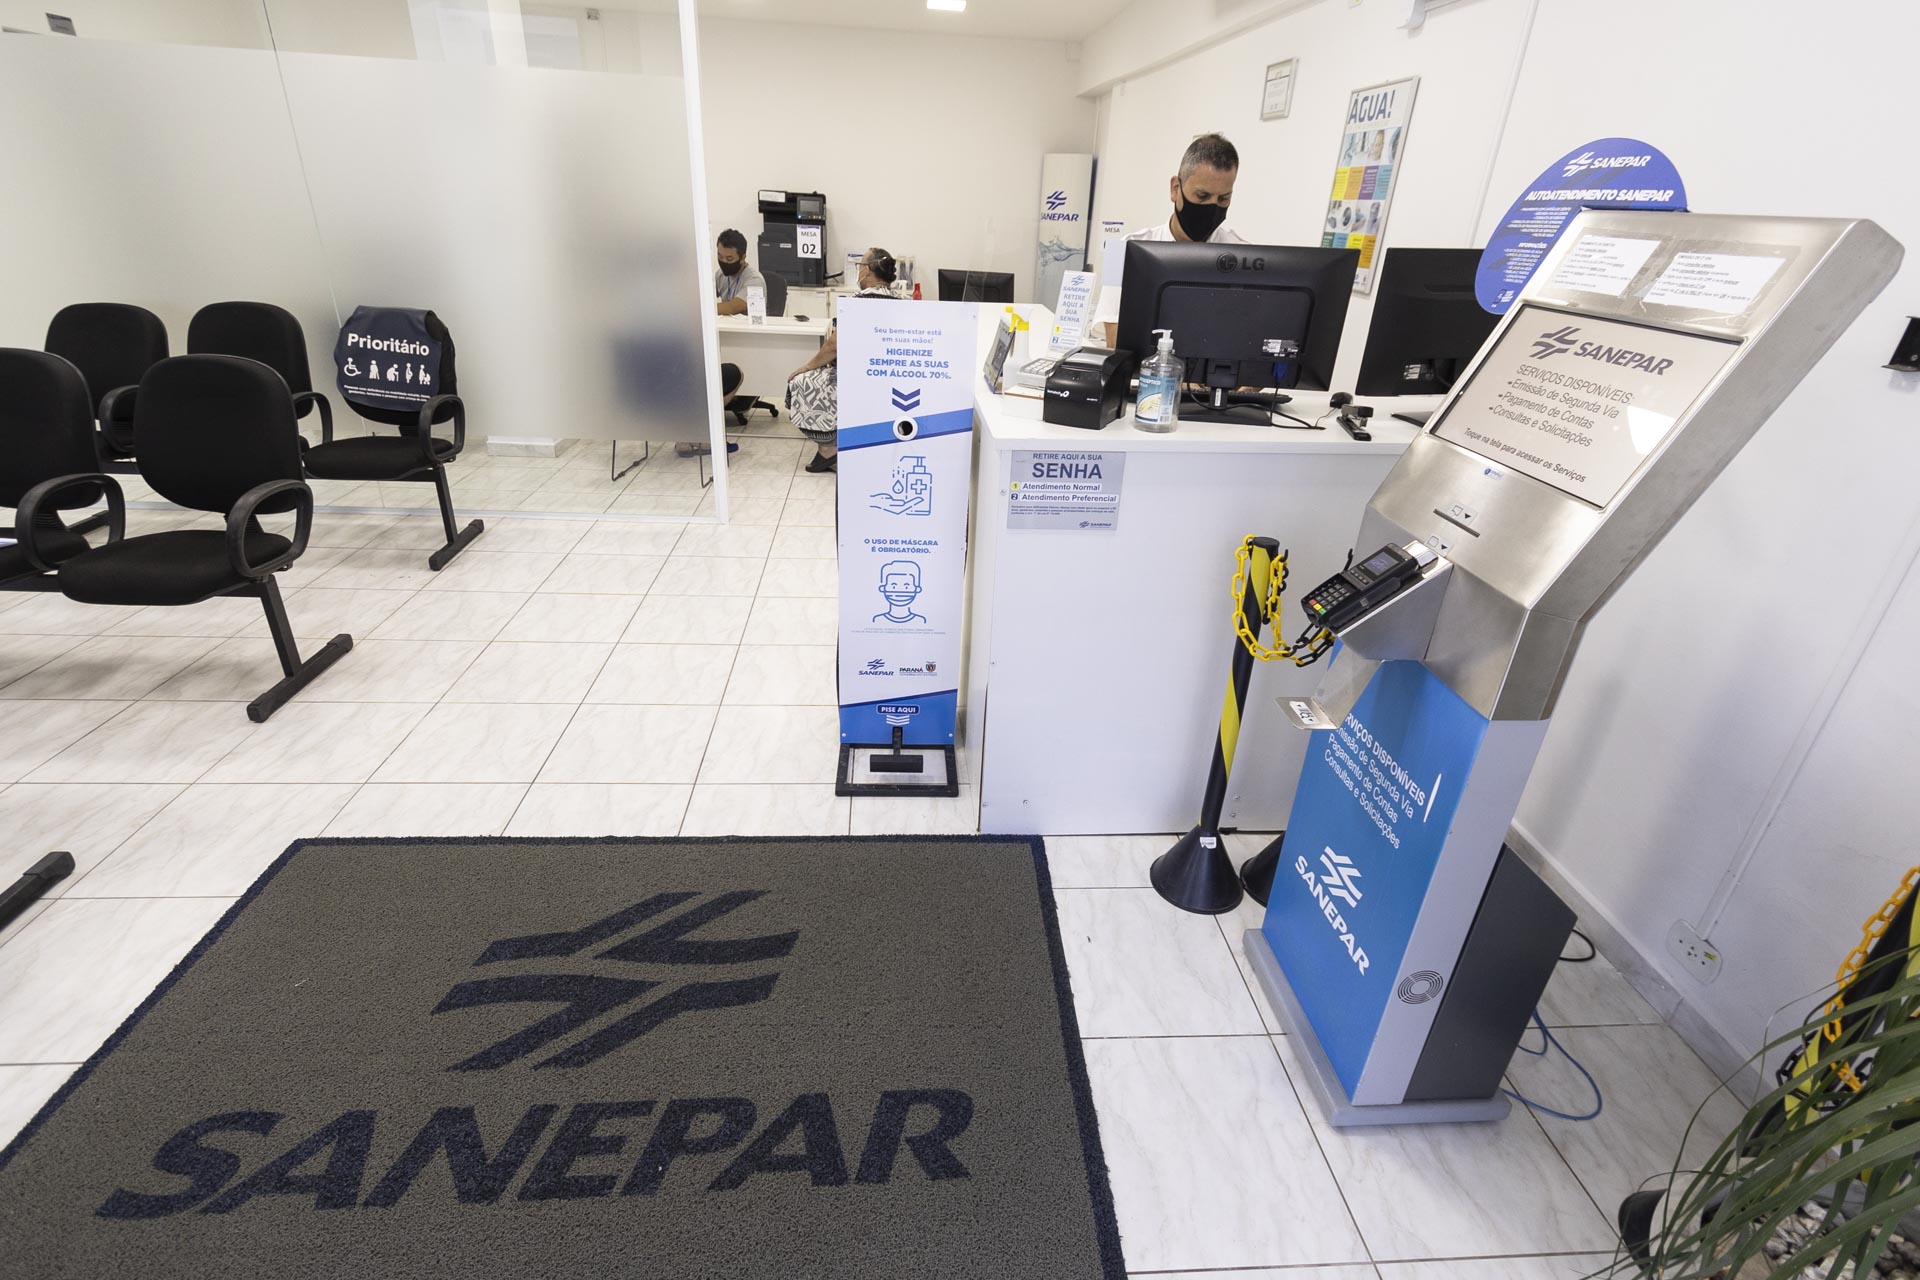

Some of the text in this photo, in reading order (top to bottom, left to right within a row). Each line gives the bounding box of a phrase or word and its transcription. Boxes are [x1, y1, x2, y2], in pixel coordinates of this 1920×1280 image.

[1347, 90, 1395, 124] ÁGUA!
[1590, 155, 1652, 169] SANEPAR
[1524, 189, 1675, 202] AUTOATENDIMENTO SANEPAR
[802, 243, 816, 254] 02
[1241, 256, 1265, 271] LG
[1060, 315, 1080, 323] SENHA
[874, 326, 942, 336] Seu bem-estar está
[912, 337, 934, 345] mãos!
[347, 333, 430, 356] Prioritário
[886, 348, 933, 358] HIGIENIZE
[869, 358, 949, 369] SEMPRE AS SUAS
[1574, 341, 1674, 376] SANEPAR
[866, 368, 952, 380] COM ÁLCOOL 70%.
[1517, 364, 1634, 405] SERVIÇOS DISPONÍVEIS:
[1511, 378, 1620, 419] Emissão de Segunda Via
[1501, 391, 1595, 429] Pagamento de Contas
[1493, 404, 1593, 448] Consultas e Solicitações
[1464, 427, 1587, 483] Toque na tela para acessar os Serviços
[1032, 462, 1102, 479] SENHA
[1022, 483, 1071, 491] Atendimento
[1073, 483, 1100, 491] Normal
[871, 545, 931, 554] É OBRIGATÓRIO.
[901, 538, 939, 546] MÁSCARA
[1345, 712, 1426, 806] RVIÇOS DISPONÍVEIS
[1328, 733, 1398, 824] Pagamento de Contas
[1336, 726, 1414, 819] missão de Segunda Via
[1324, 749, 1400, 849] Consultas e Solicitações
[1295, 855, 1370, 976] SANEPAR
[93, 1086, 976, 1218] SANEPAR
